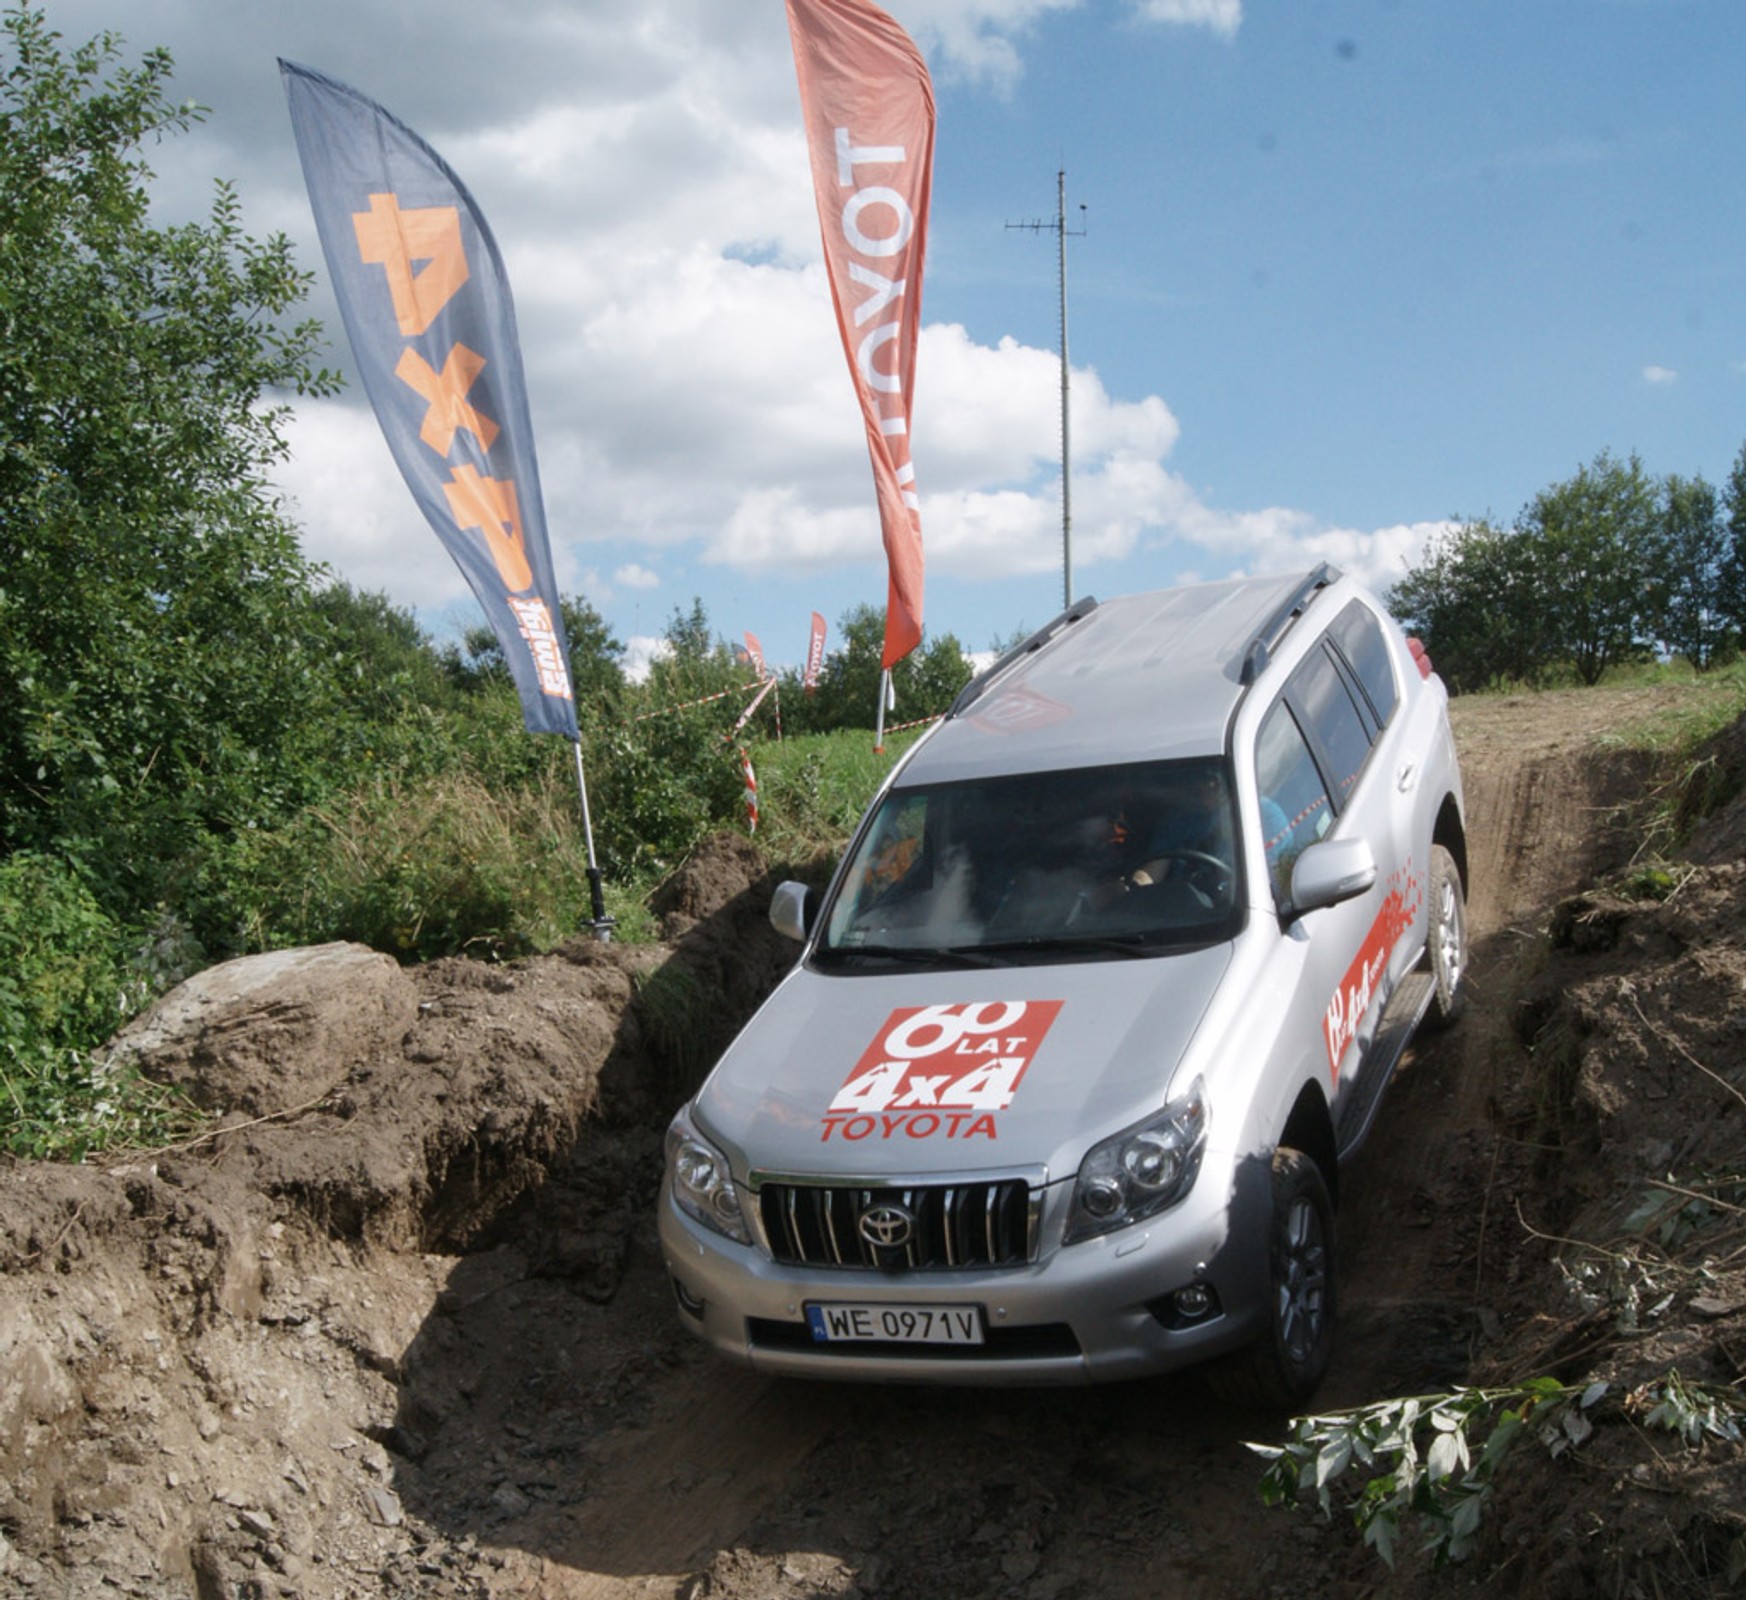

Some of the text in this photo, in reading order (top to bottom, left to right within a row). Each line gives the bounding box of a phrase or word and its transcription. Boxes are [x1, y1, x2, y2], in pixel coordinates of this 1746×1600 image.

[884, 1000, 1028, 1060] 60
[955, 1036, 1028, 1055] LAT
[828, 1056, 1026, 1113] 4x4
[820, 1112, 998, 1142] TOYOTA
[827, 1309, 973, 1340] WE 0971V
